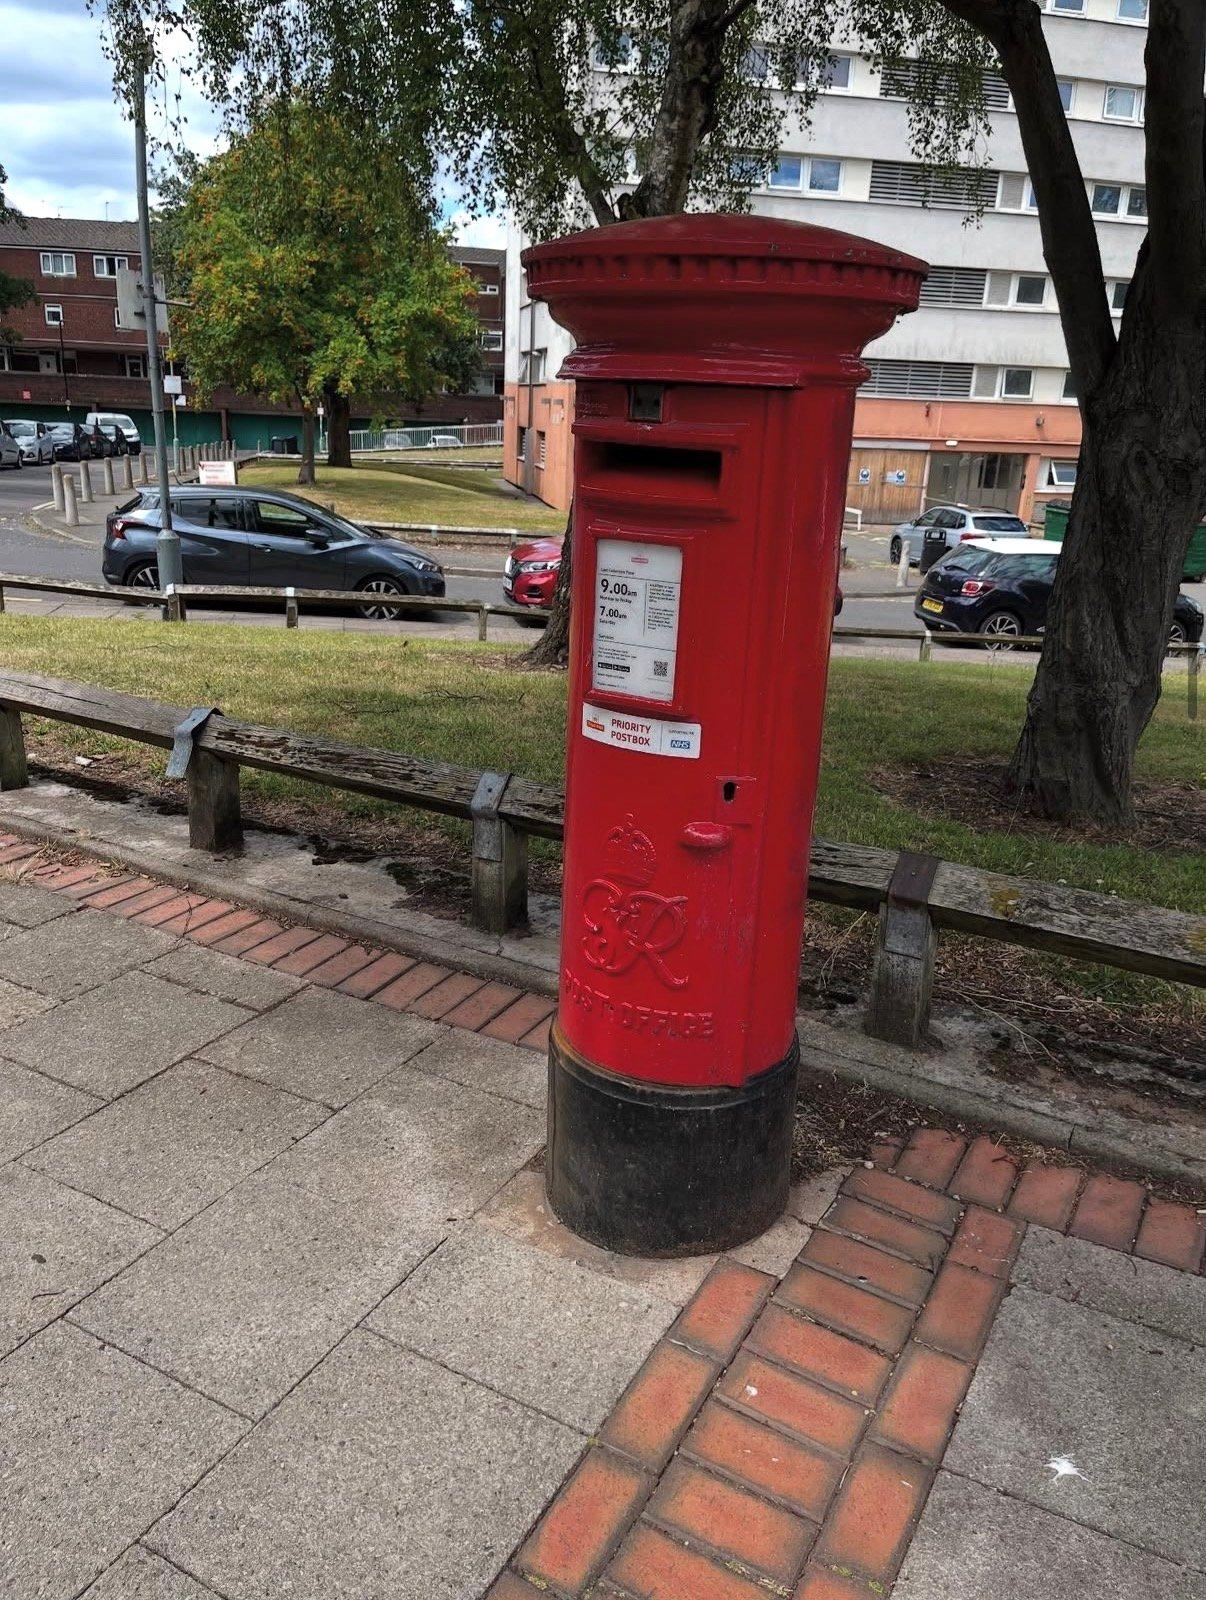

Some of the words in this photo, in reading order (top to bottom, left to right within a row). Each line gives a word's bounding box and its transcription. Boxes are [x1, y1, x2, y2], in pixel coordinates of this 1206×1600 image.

[601, 578, 638, 596] 9.00am
[599, 606, 627, 619] 7.00am
[611, 718, 652, 734] PRIORITY
[610, 730, 651, 746] POSTBOX
[671, 739, 690, 749] NHS
[621, 1001, 713, 1040] OFFICE
